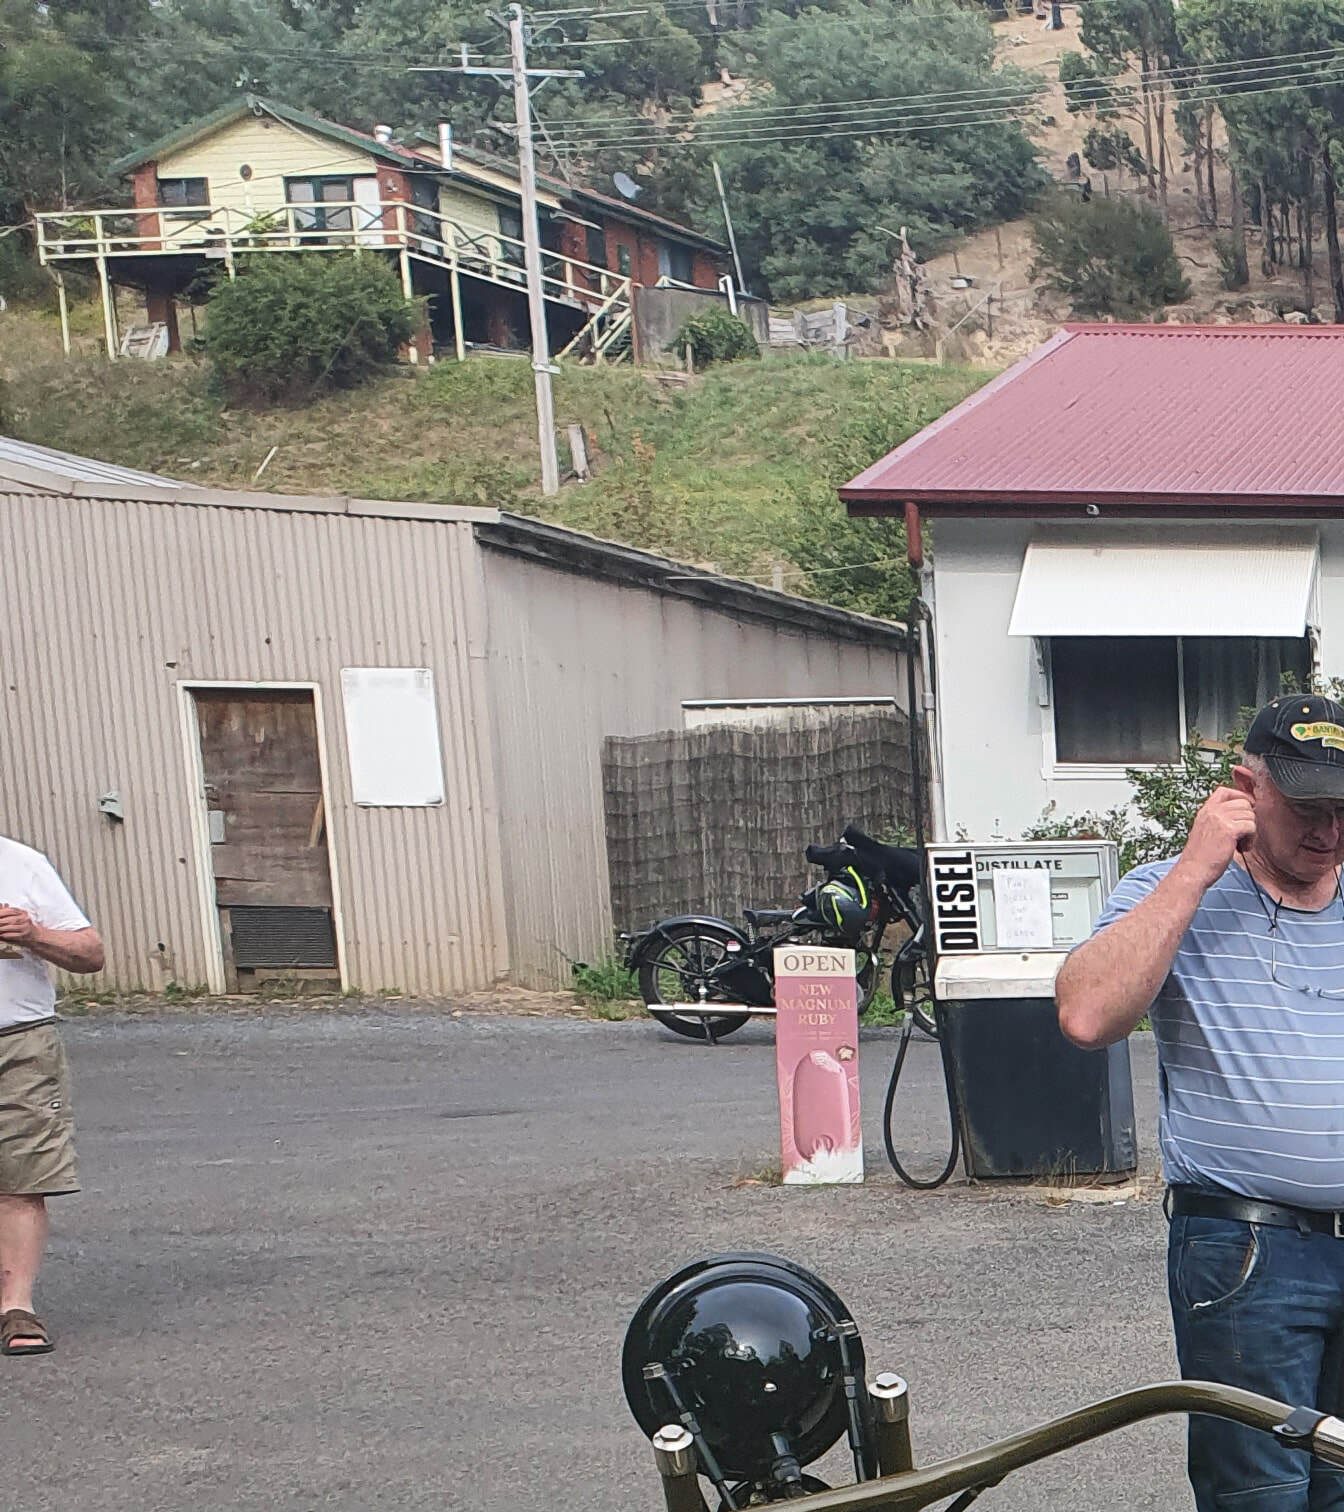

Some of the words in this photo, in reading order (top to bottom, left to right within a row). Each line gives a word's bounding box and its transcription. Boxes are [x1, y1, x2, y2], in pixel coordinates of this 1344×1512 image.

[975, 859, 1063, 872] DISTILLATE
[933, 851, 980, 951] DIESEL
[783, 954, 847, 972] OPEN
[798, 983, 834, 996] NEW
[780, 998, 852, 1011] MAGNUM
[798, 1013, 837, 1025] RUBY
